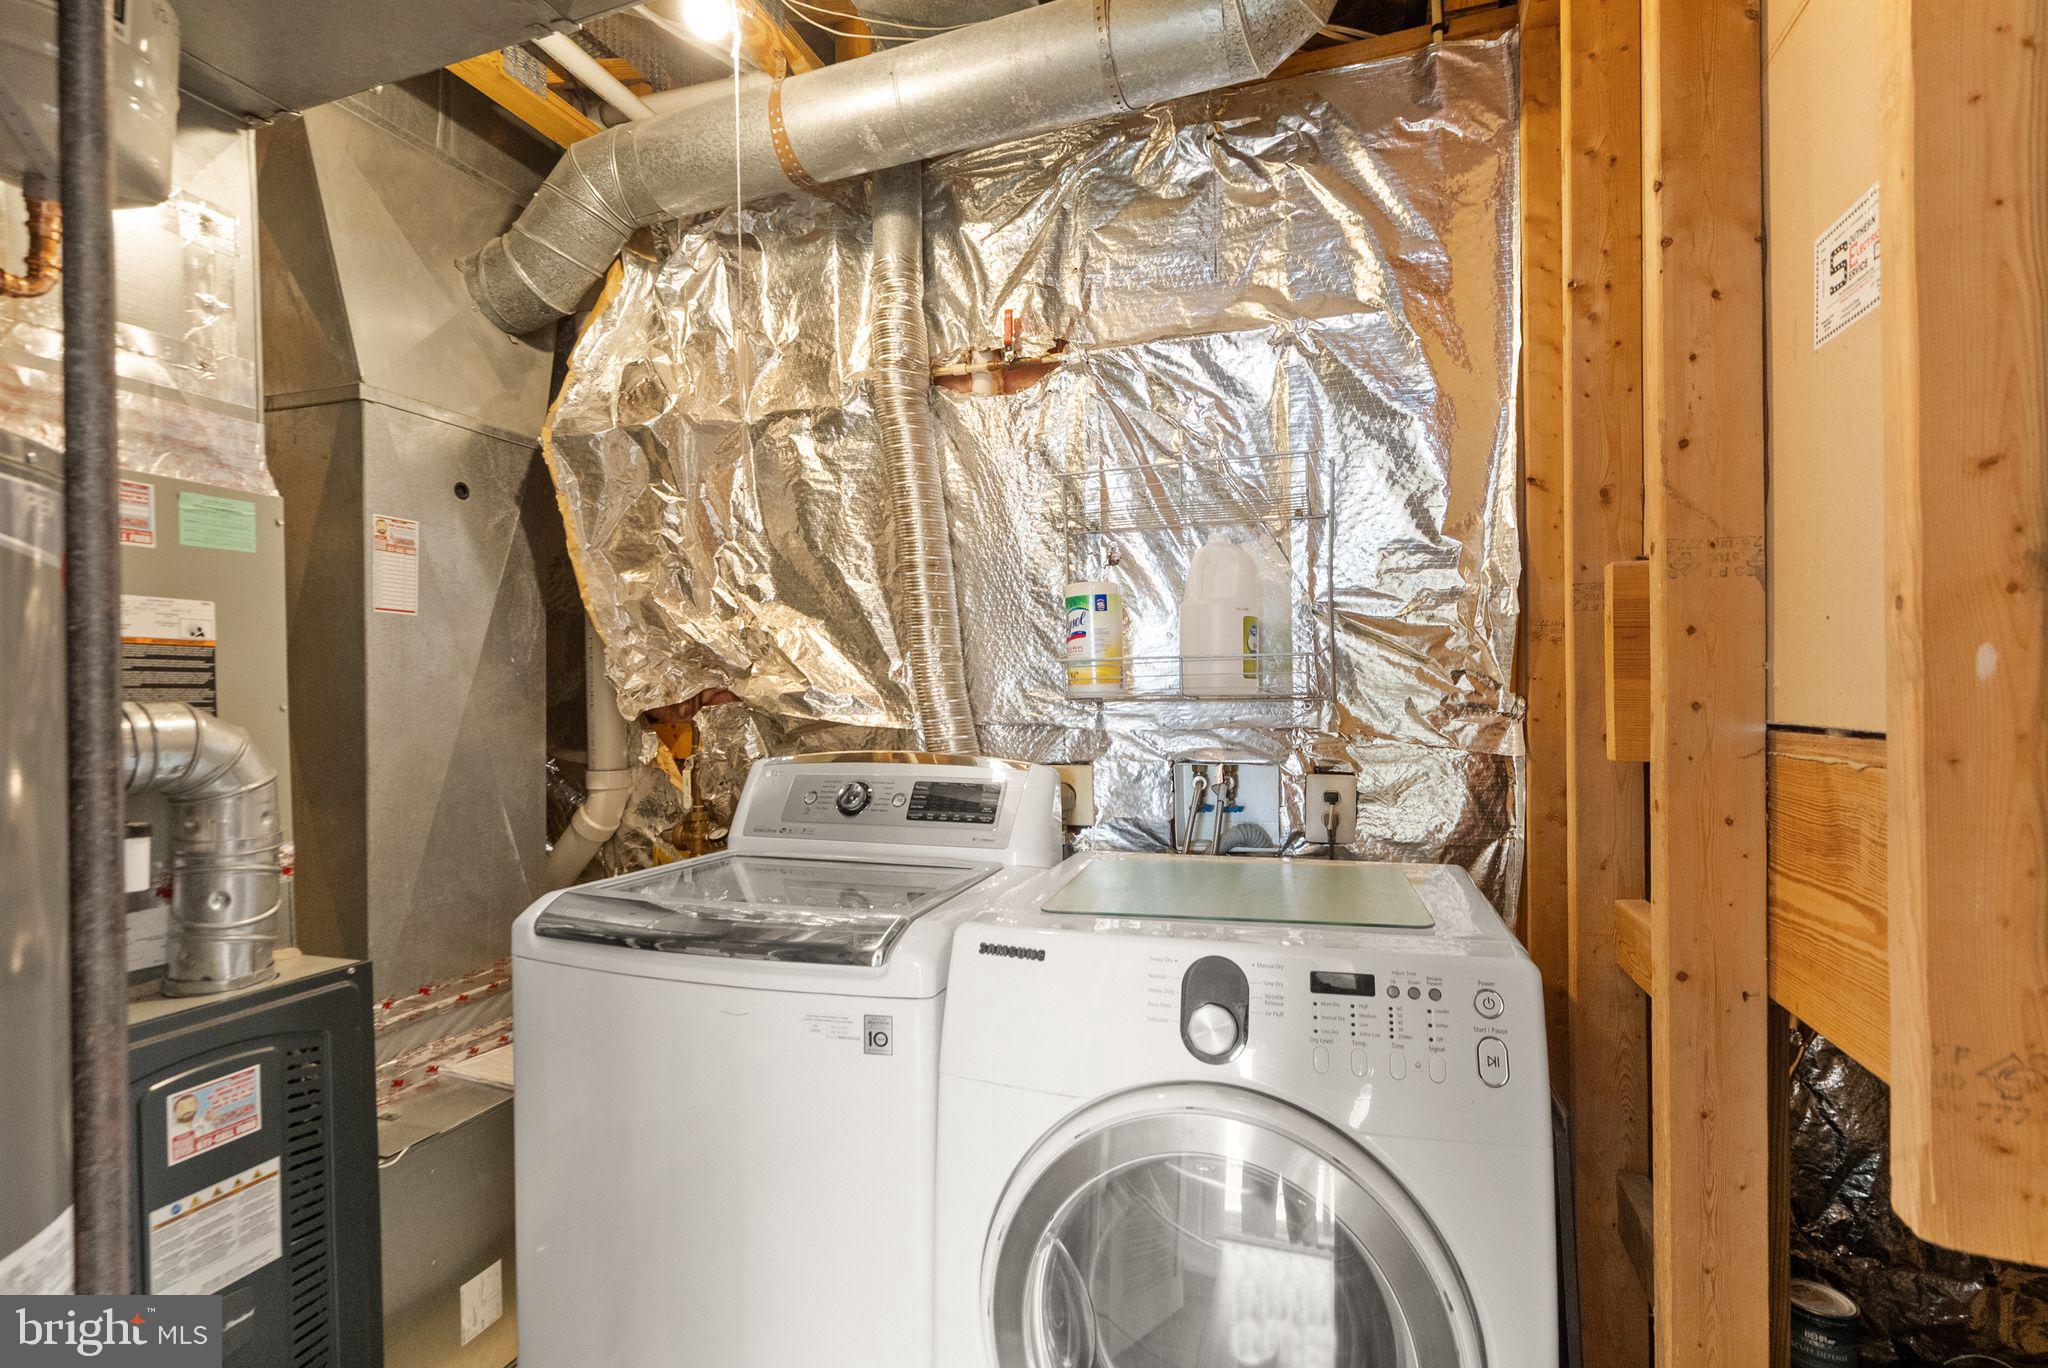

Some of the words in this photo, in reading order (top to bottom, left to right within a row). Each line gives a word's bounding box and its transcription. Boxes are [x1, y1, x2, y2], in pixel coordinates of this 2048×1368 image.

[1066, 611, 1087, 632] ysol
[979, 942, 1045, 961] SAMSUNG
[868, 1031, 889, 1048] 10
[1428, 1045, 1446, 1053] Signal
